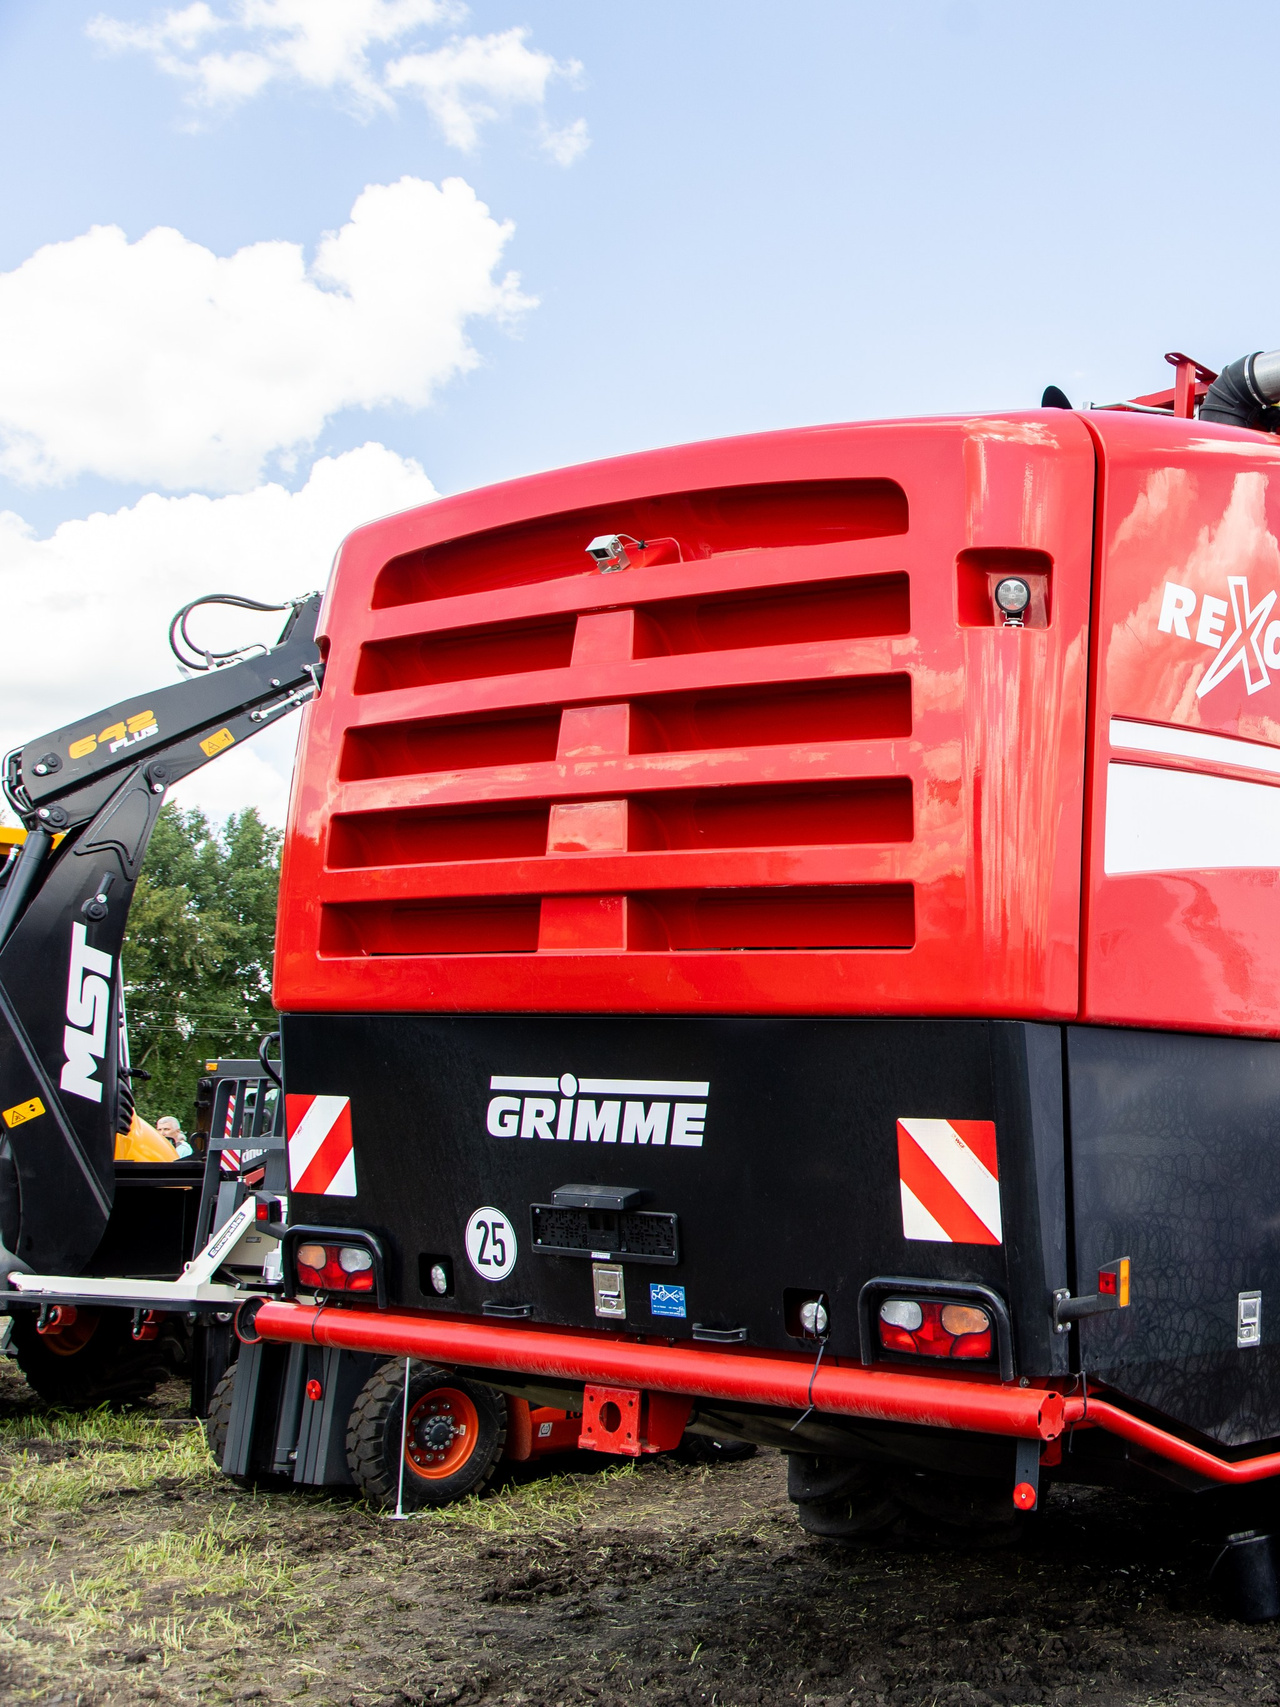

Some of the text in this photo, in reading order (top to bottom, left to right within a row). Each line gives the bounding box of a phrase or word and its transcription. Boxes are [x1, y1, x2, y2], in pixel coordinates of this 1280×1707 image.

[68, 709, 157, 760] 642
[109, 723, 159, 754] PLUS
[60, 920, 114, 1103] MST
[486, 1073, 709, 1147] GRIMME
[476, 1220, 506, 1267] 25
